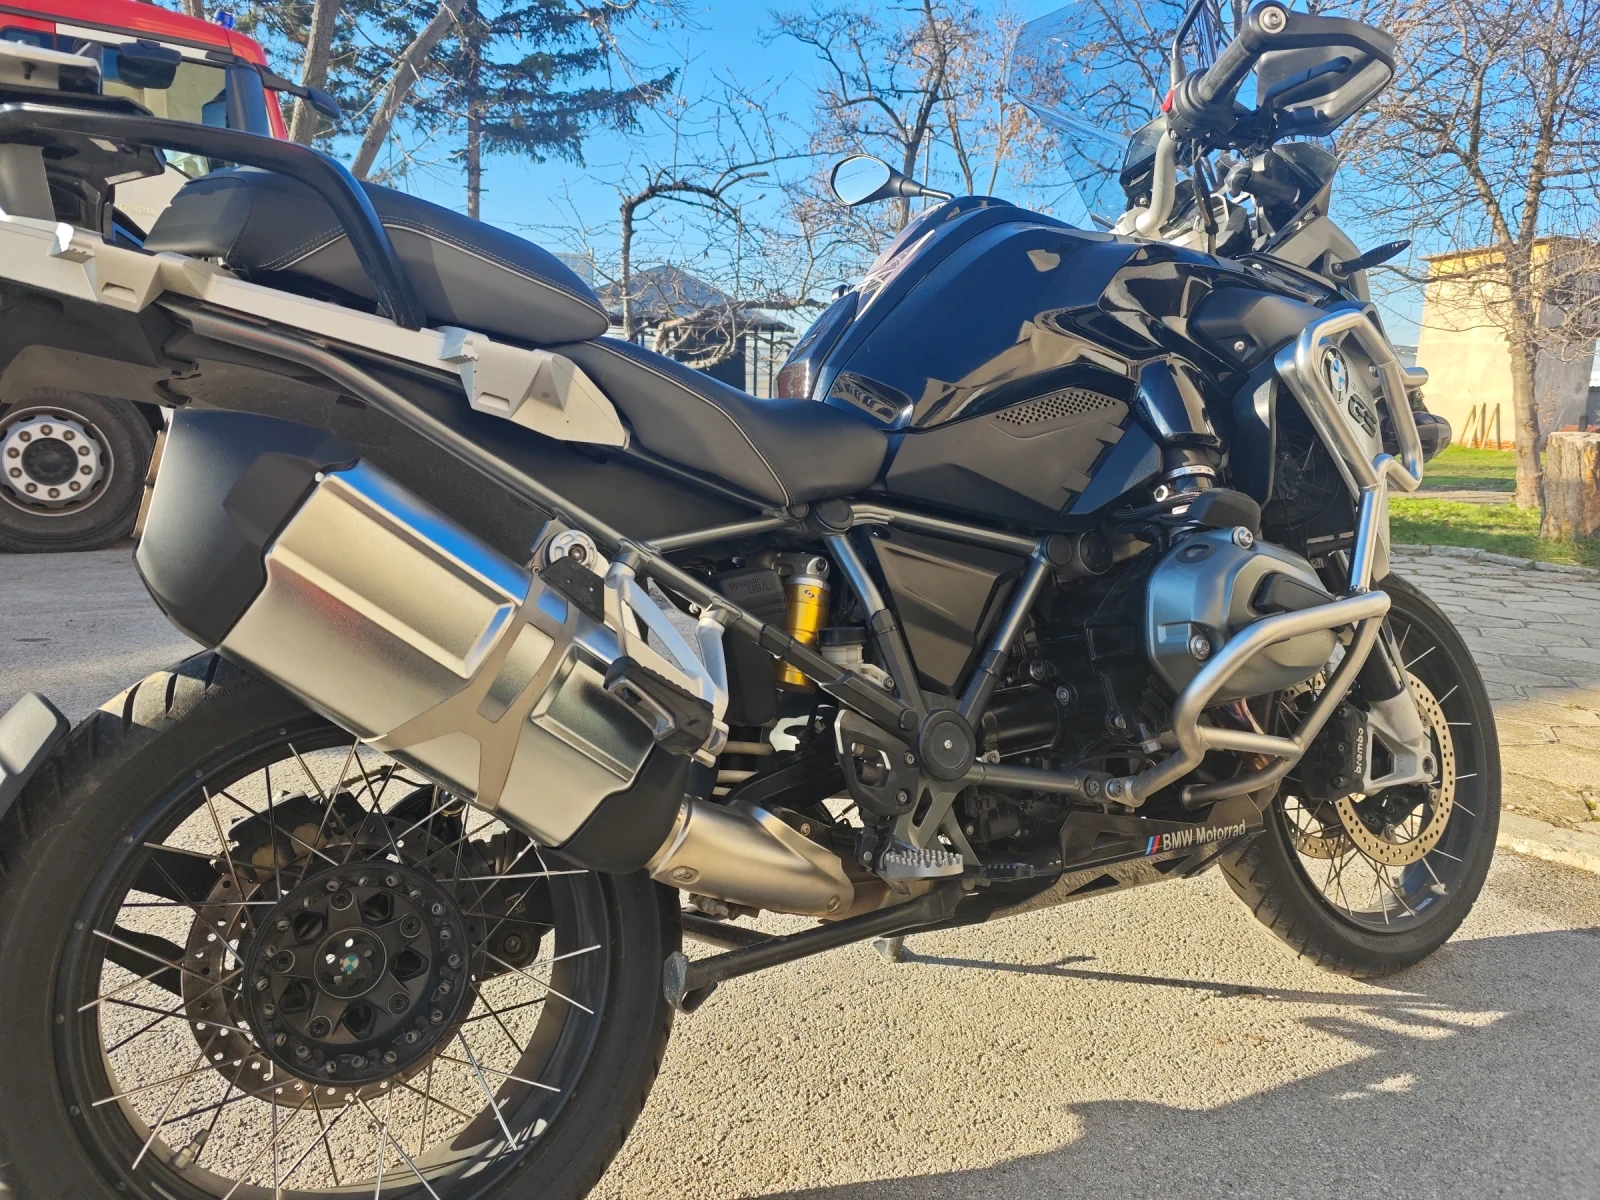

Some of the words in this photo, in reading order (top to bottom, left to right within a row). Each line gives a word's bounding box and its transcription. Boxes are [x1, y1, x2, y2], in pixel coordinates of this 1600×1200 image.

[1347, 393, 1378, 439] GS
[1354, 727, 1364, 774] brembo
[1162, 828, 1193, 851] BMW
[1196, 819, 1246, 844] Motorrad
